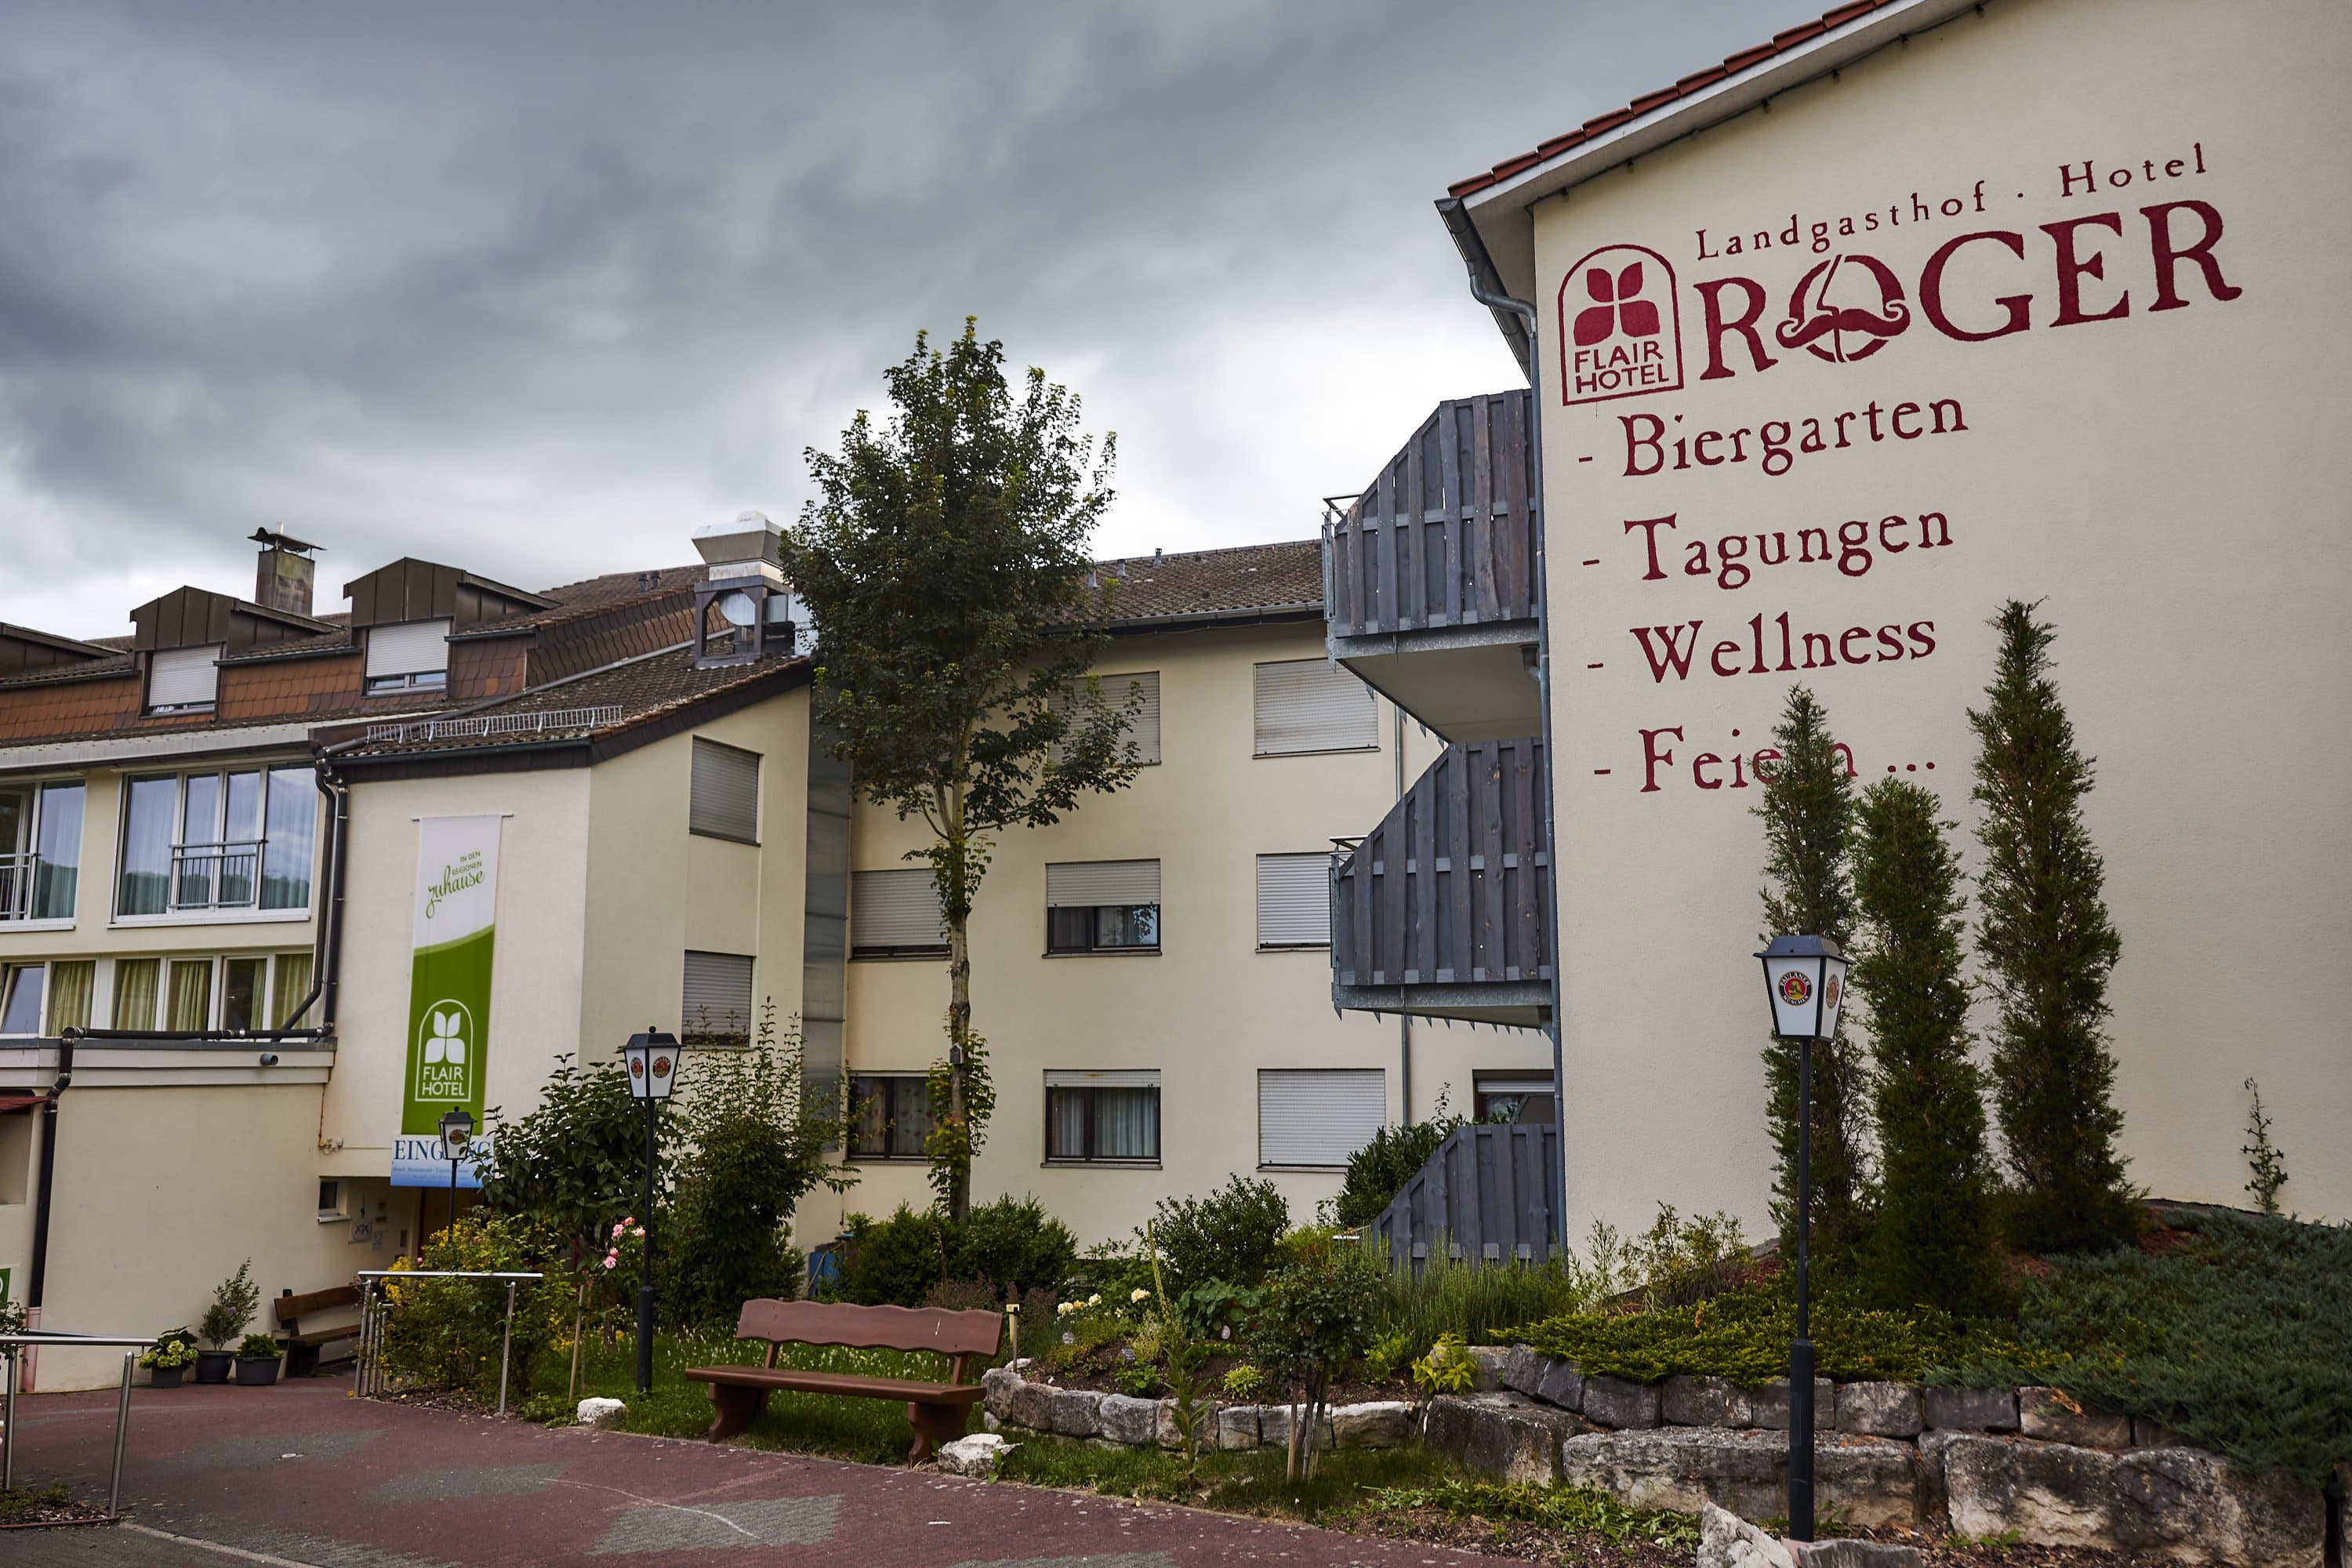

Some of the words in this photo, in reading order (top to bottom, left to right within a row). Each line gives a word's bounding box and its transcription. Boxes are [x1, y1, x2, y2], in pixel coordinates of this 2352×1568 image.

[1696, 179, 1989, 261] Landgasthof
[2059, 143, 2208, 198] Hotel
[1693, 199, 2244, 381] ROGER
[1573, 340, 1664, 375] FLAIR
[1574, 363, 1671, 394] HOTEL
[1617, 397, 1969, 477] Biergarten
[1623, 512, 1954, 590] Tagungen
[1629, 611, 1936, 683] Wellness
[1638, 725, 1859, 793] Feien
[452, 861, 482, 876] REGIONEN
[468, 850, 481, 860] DEN
[426, 865, 485, 919] zuhause
[422, 1081, 464, 1096] HOTEL
[423, 1066, 463, 1080] FLAIR
